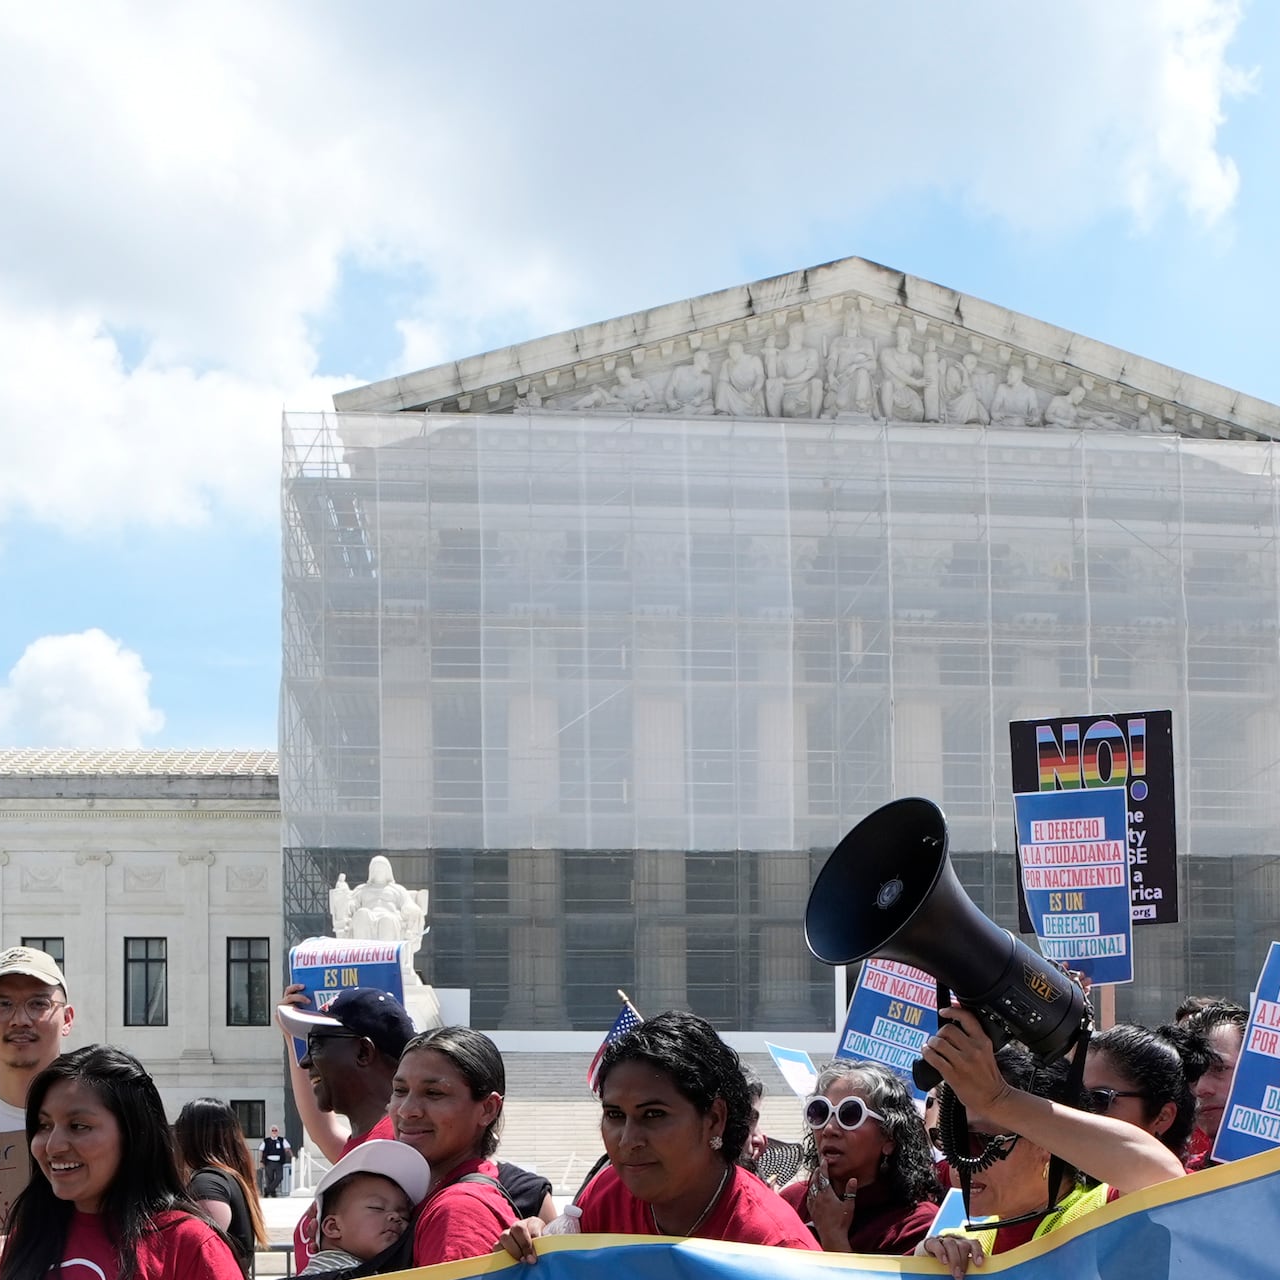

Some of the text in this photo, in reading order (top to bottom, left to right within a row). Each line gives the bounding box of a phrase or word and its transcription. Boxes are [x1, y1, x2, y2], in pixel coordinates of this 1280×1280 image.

[1036, 719, 1148, 801] NO!
[1035, 820, 1099, 841] EL DERECHO
[1023, 847, 1029, 864] A
[1031, 846, 1042, 864] LA
[1025, 867, 1121, 887] POR NACIMIENTO
[1049, 892, 1083, 911] ES UN
[1045, 915, 1095, 934] DERECHO
[324, 968, 358, 987] ES UN
[865, 970, 888, 993] POR
[1031, 976, 1052, 998] UZI
[887, 1000, 923, 1026] ES UN
[1257, 1003, 1267, 1024] A
[875, 1020, 924, 1049] DERECHO
[1251, 1029, 1278, 1054] POR
[846, 1033, 921, 1069] CONSTITUCIO
